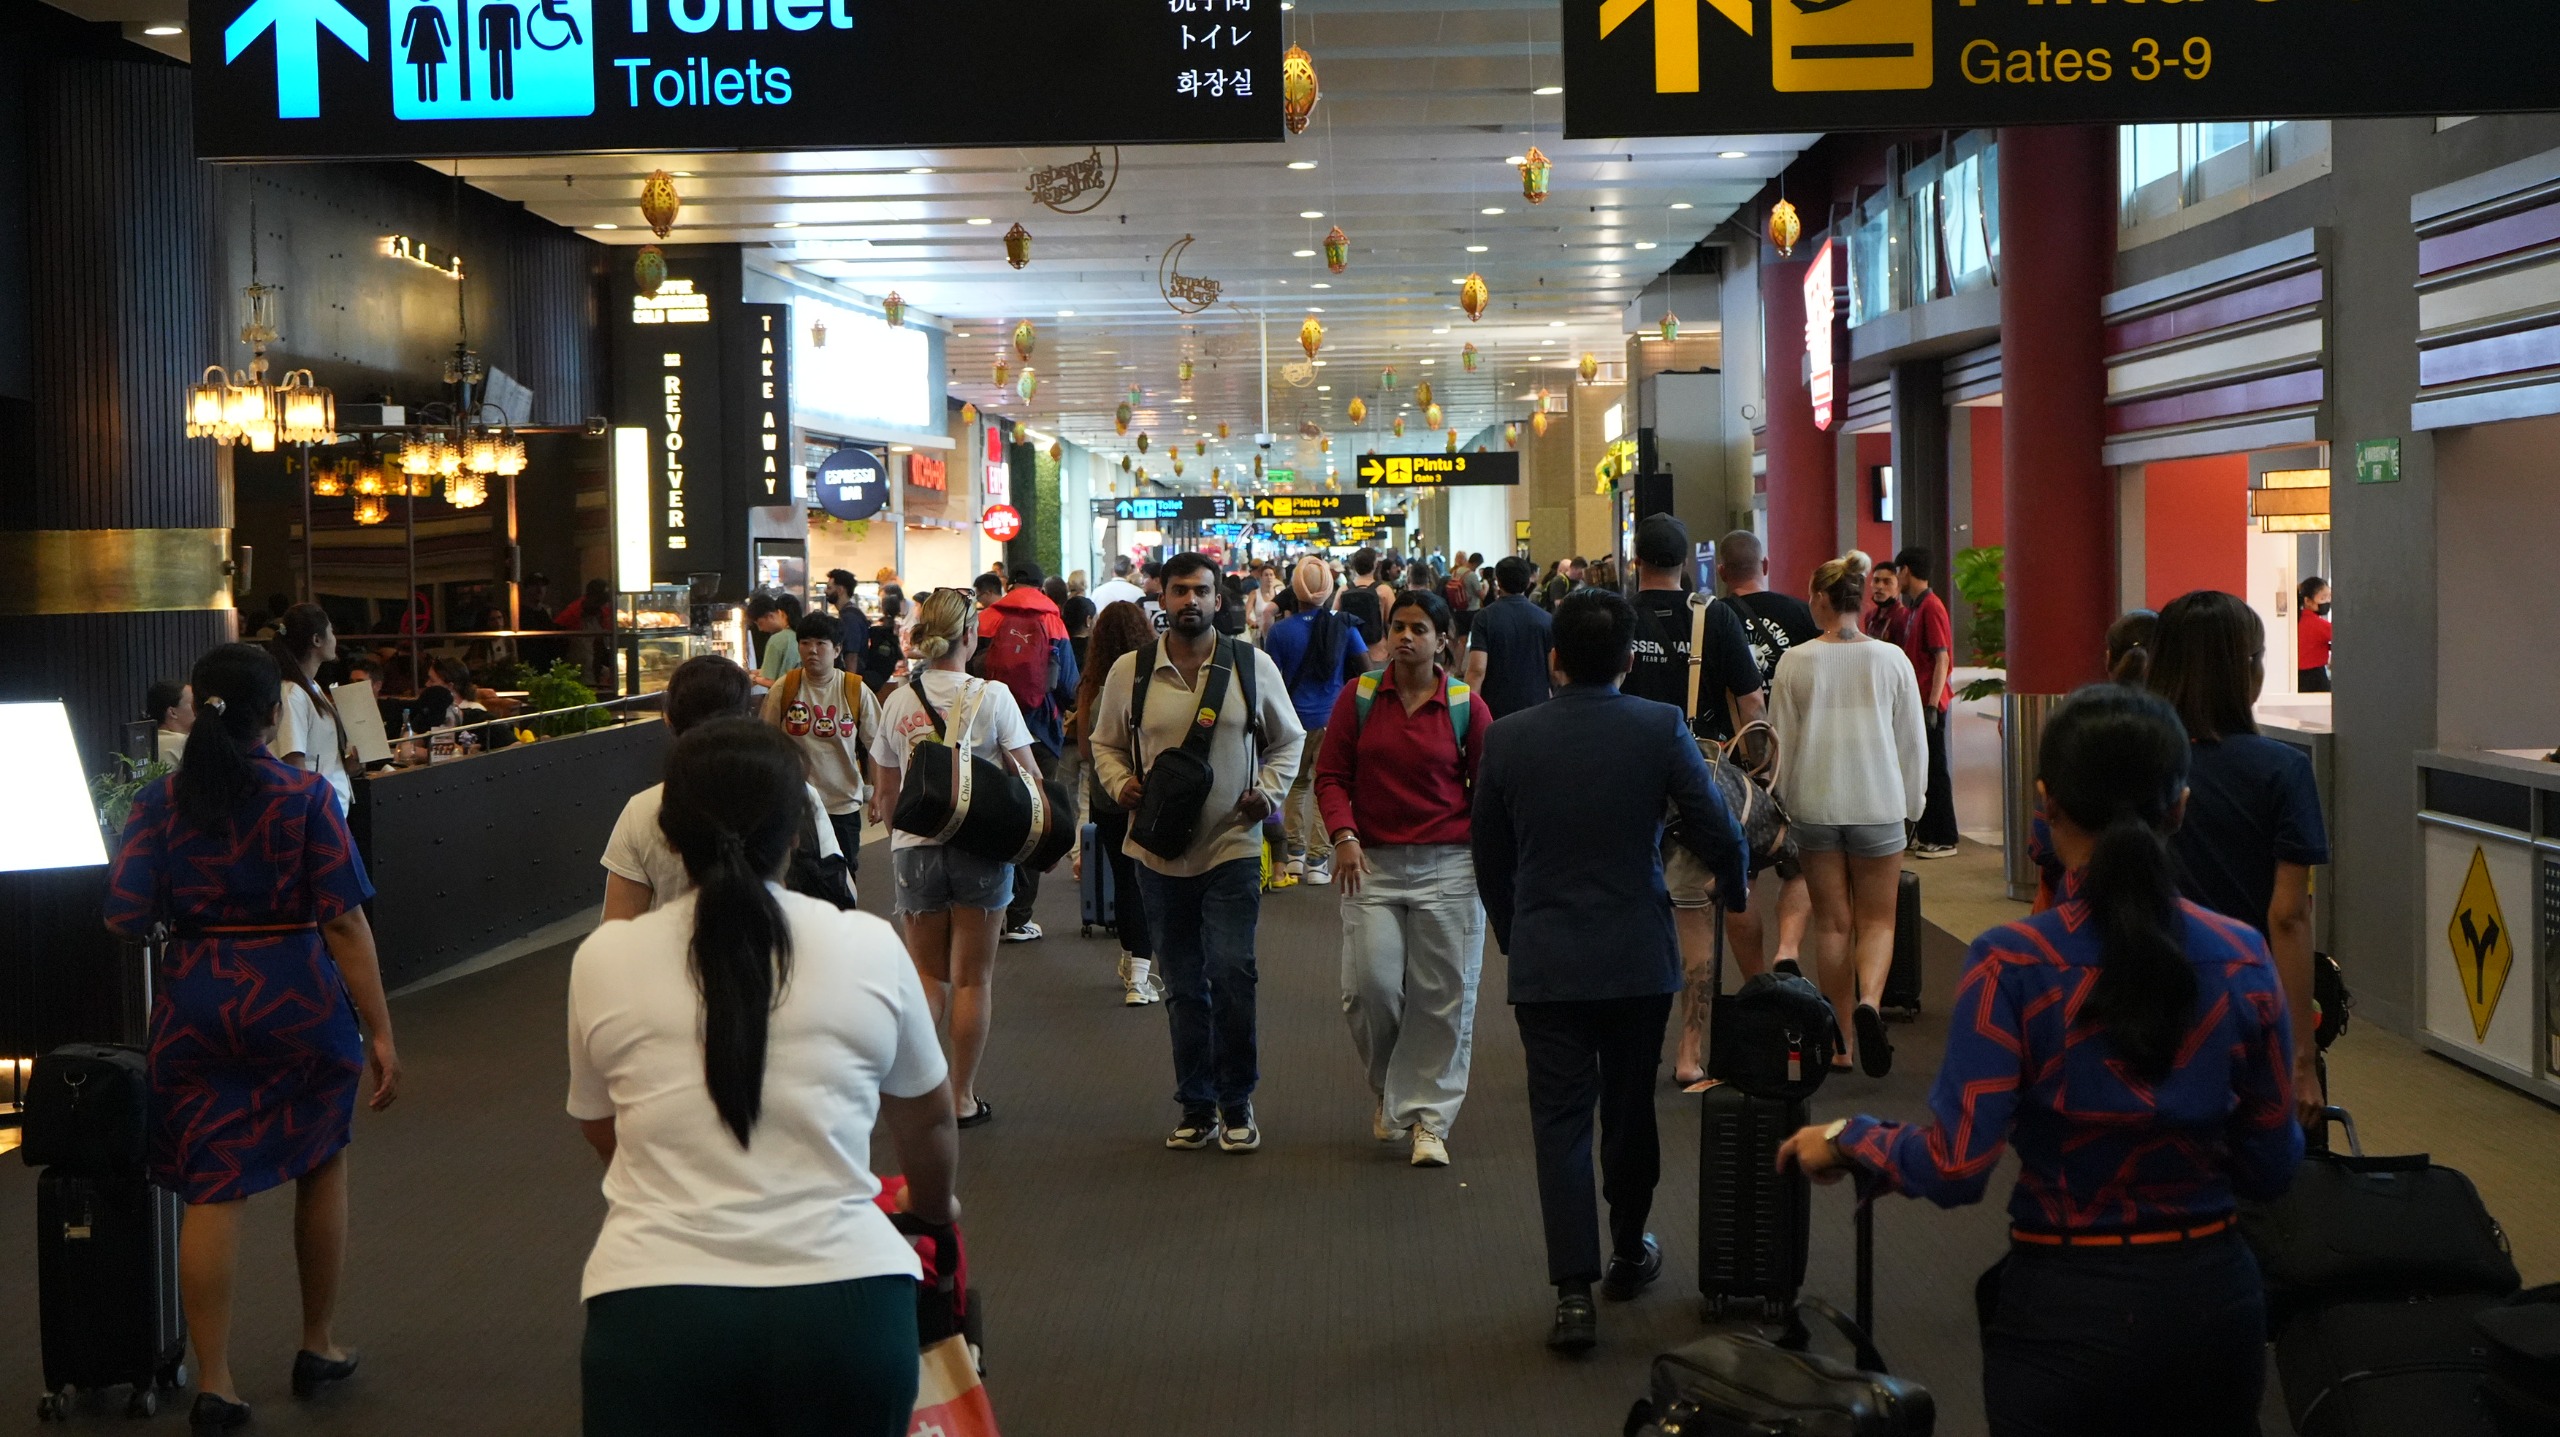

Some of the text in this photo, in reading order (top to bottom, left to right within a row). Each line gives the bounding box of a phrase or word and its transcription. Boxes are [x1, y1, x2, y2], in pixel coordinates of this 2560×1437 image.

[1181, 24, 1252, 50] トイレ
[1960, 37, 2213, 84] Gates 3-9
[613, 56, 793, 108] Toilets
[1176, 68, 1253, 98] 화장실
[761, 315, 777, 495] TAKE AWAY
[664, 375, 685, 528] REVOLVER
[1413, 457, 1466, 472] Pintu 3
[1157, 499, 1183, 510] Toilet
[1293, 498, 1320, 508] Pintu
[960, 775, 971, 802] Chloé
